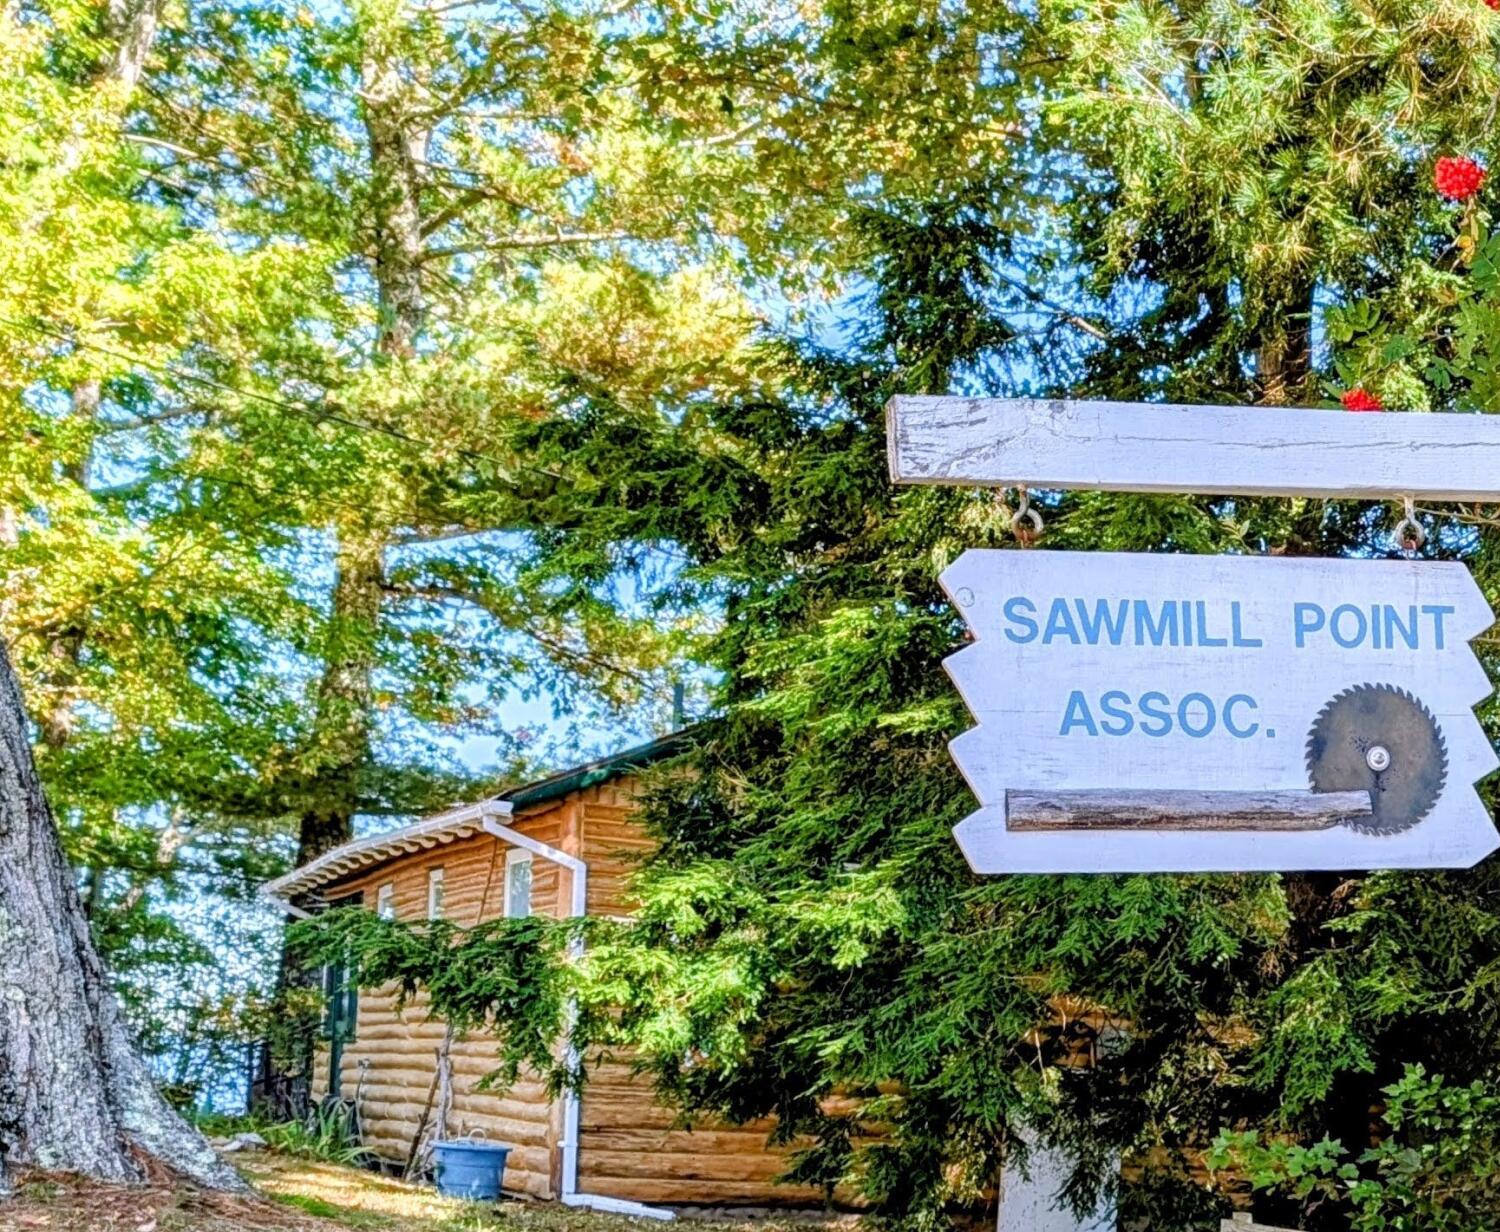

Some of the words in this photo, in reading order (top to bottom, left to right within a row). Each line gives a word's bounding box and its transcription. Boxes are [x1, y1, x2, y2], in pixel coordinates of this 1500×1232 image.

[1003, 597, 1263, 648] SAWMILL
[1293, 603, 1455, 650] POINT
[1059, 689, 1276, 739] ASSOC.
